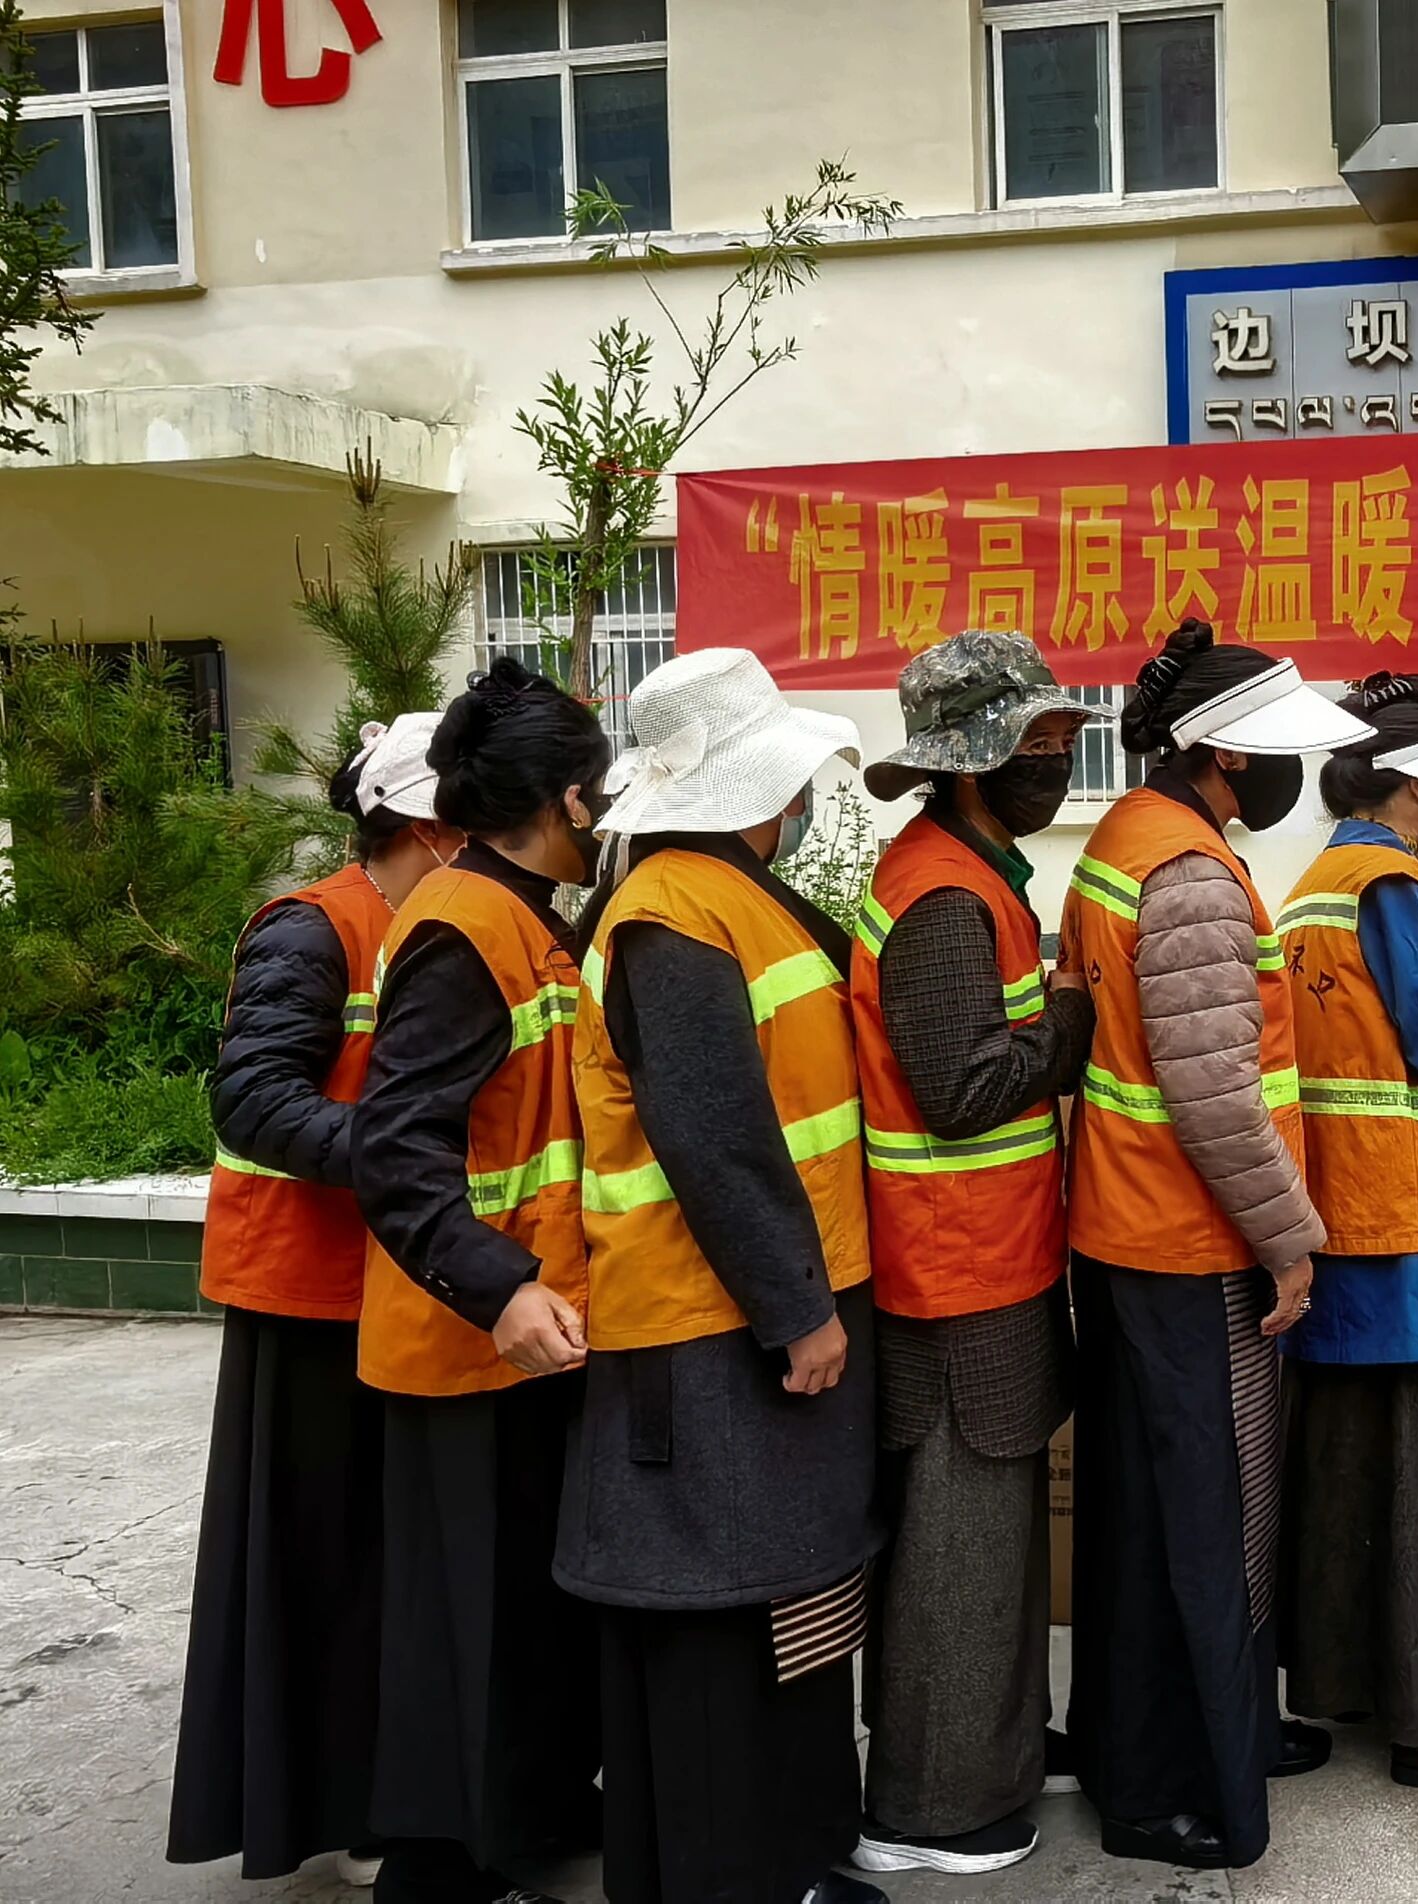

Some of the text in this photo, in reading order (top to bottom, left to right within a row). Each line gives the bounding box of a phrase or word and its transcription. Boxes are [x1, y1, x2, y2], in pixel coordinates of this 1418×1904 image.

[745, 464, 1414, 661] “情暖高原送温暖
